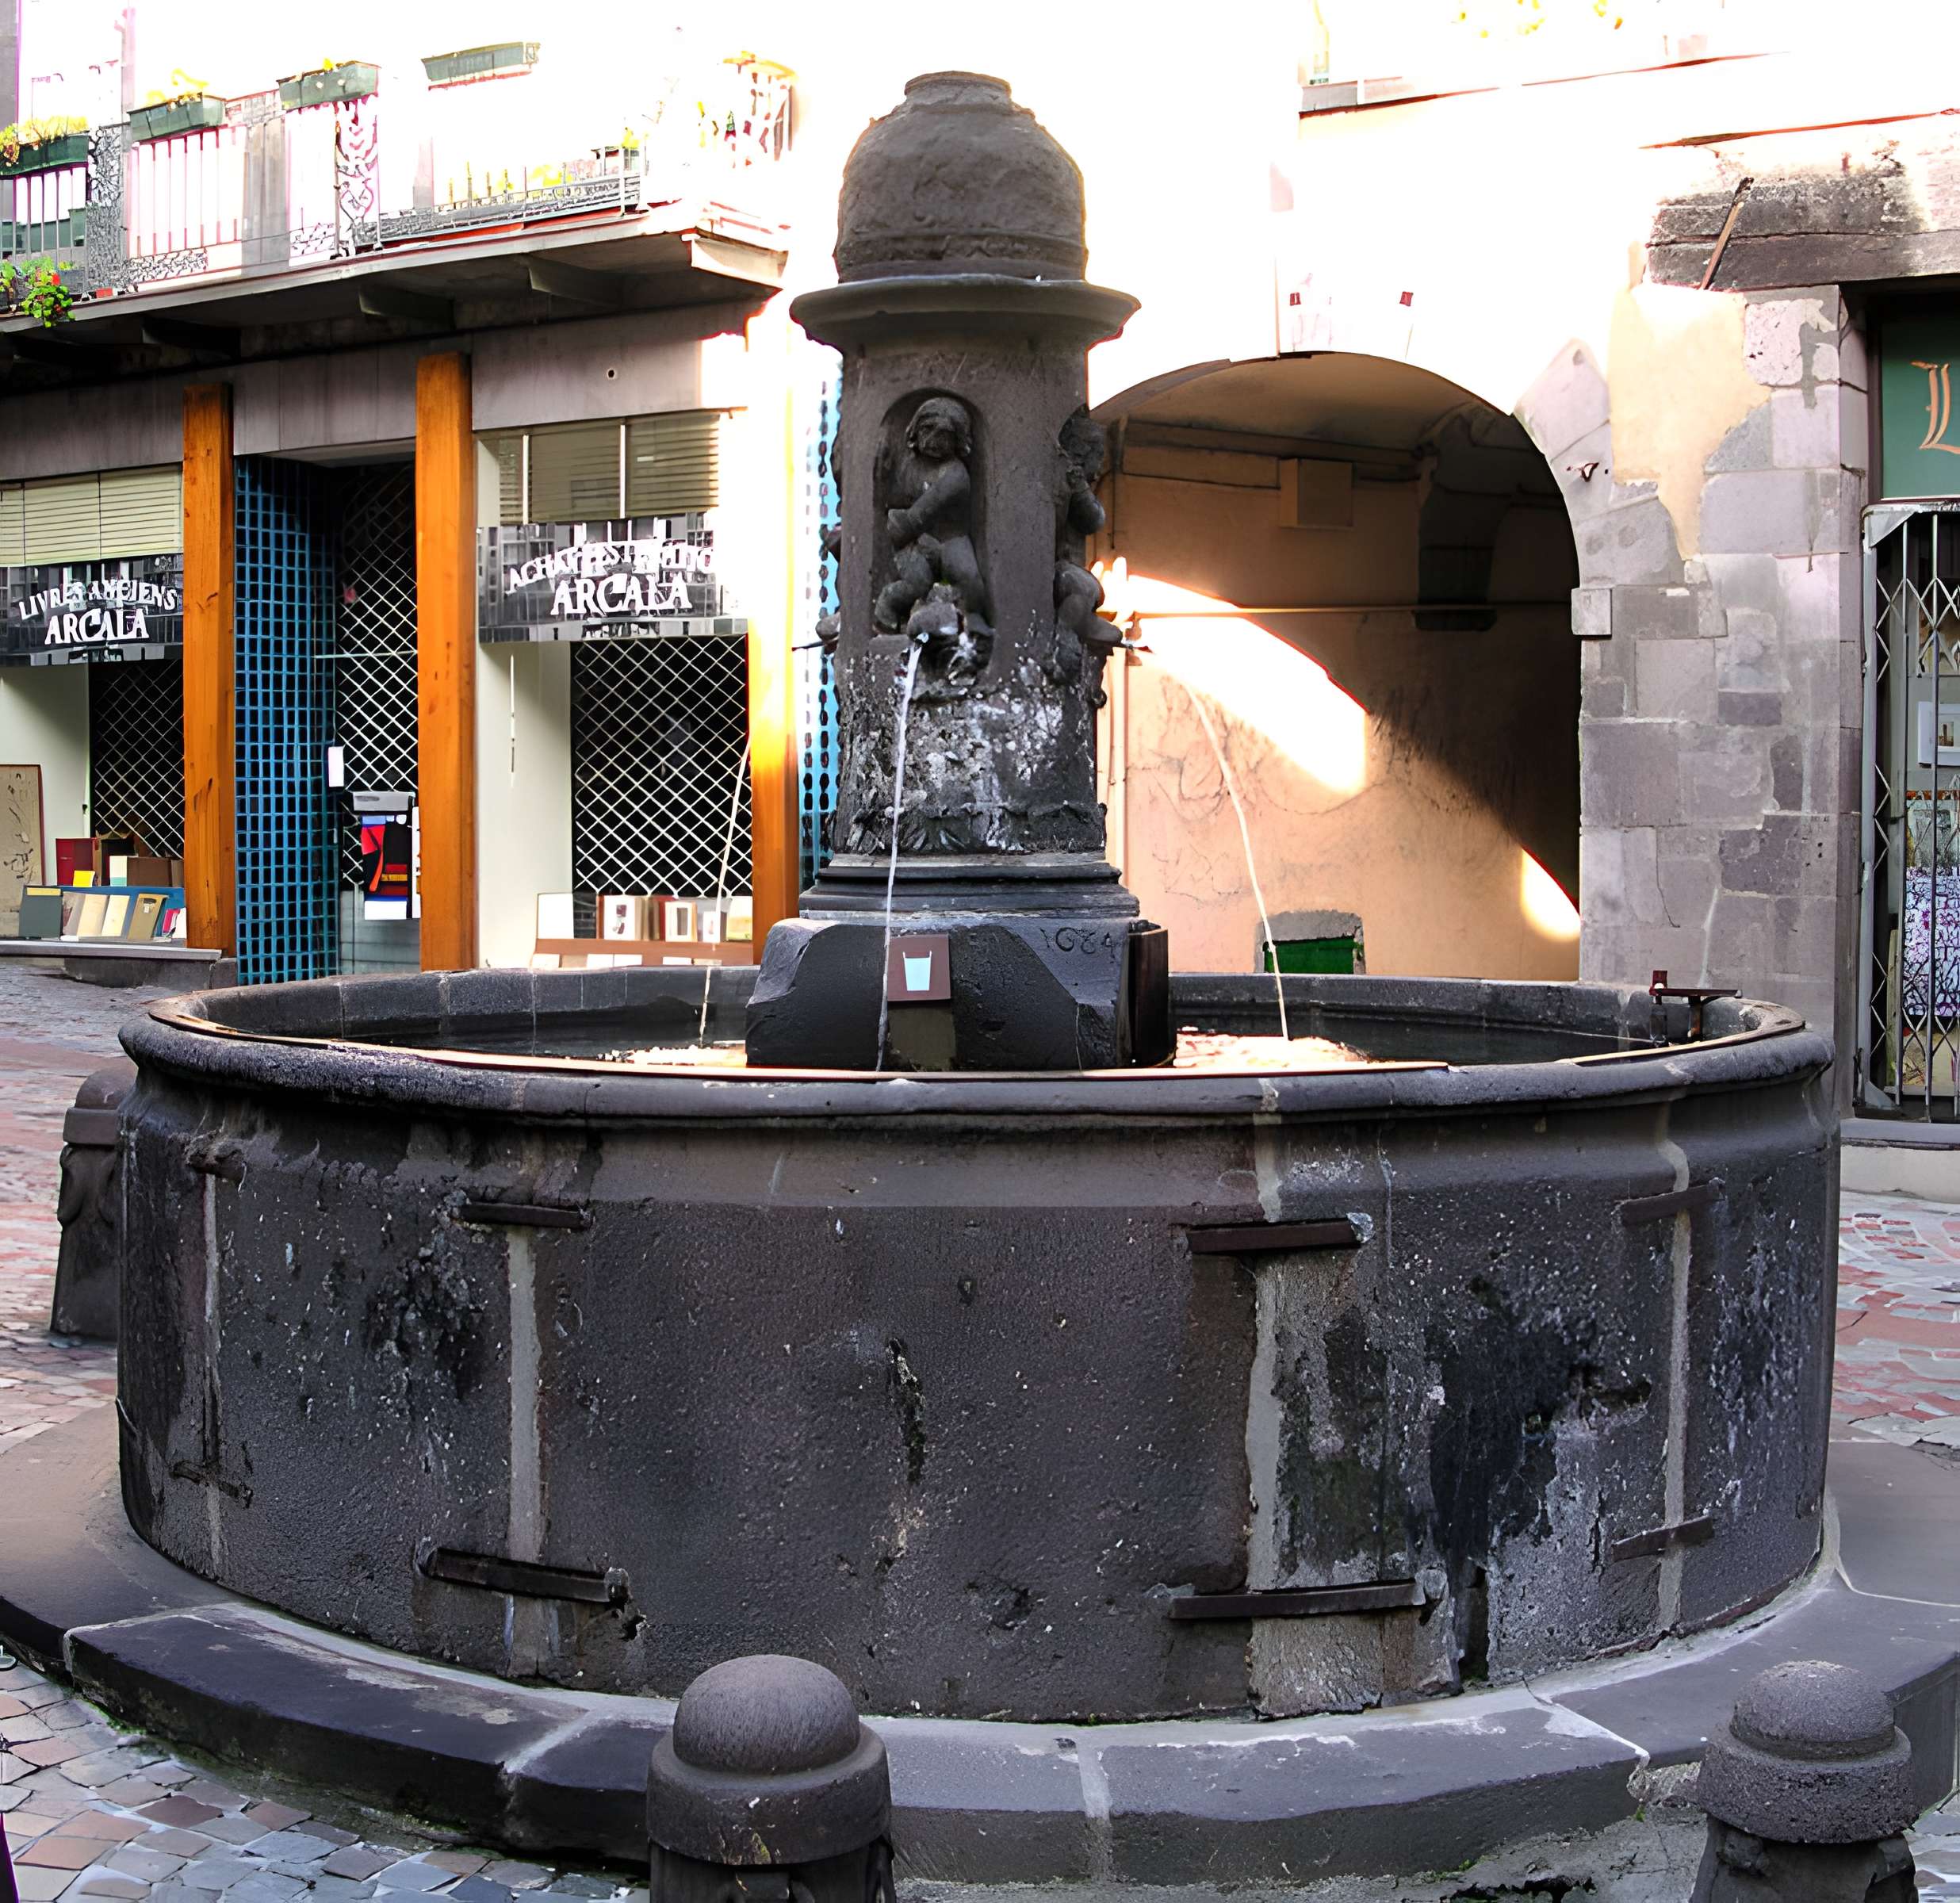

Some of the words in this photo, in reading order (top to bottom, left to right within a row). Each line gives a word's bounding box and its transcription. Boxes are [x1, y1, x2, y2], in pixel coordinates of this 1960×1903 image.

[19, 581, 85, 620] LIVRES
[89, 579, 178, 611] ANCIENS
[550, 572, 692, 615] ARCALA
[44, 607, 150, 645] ARCALA
